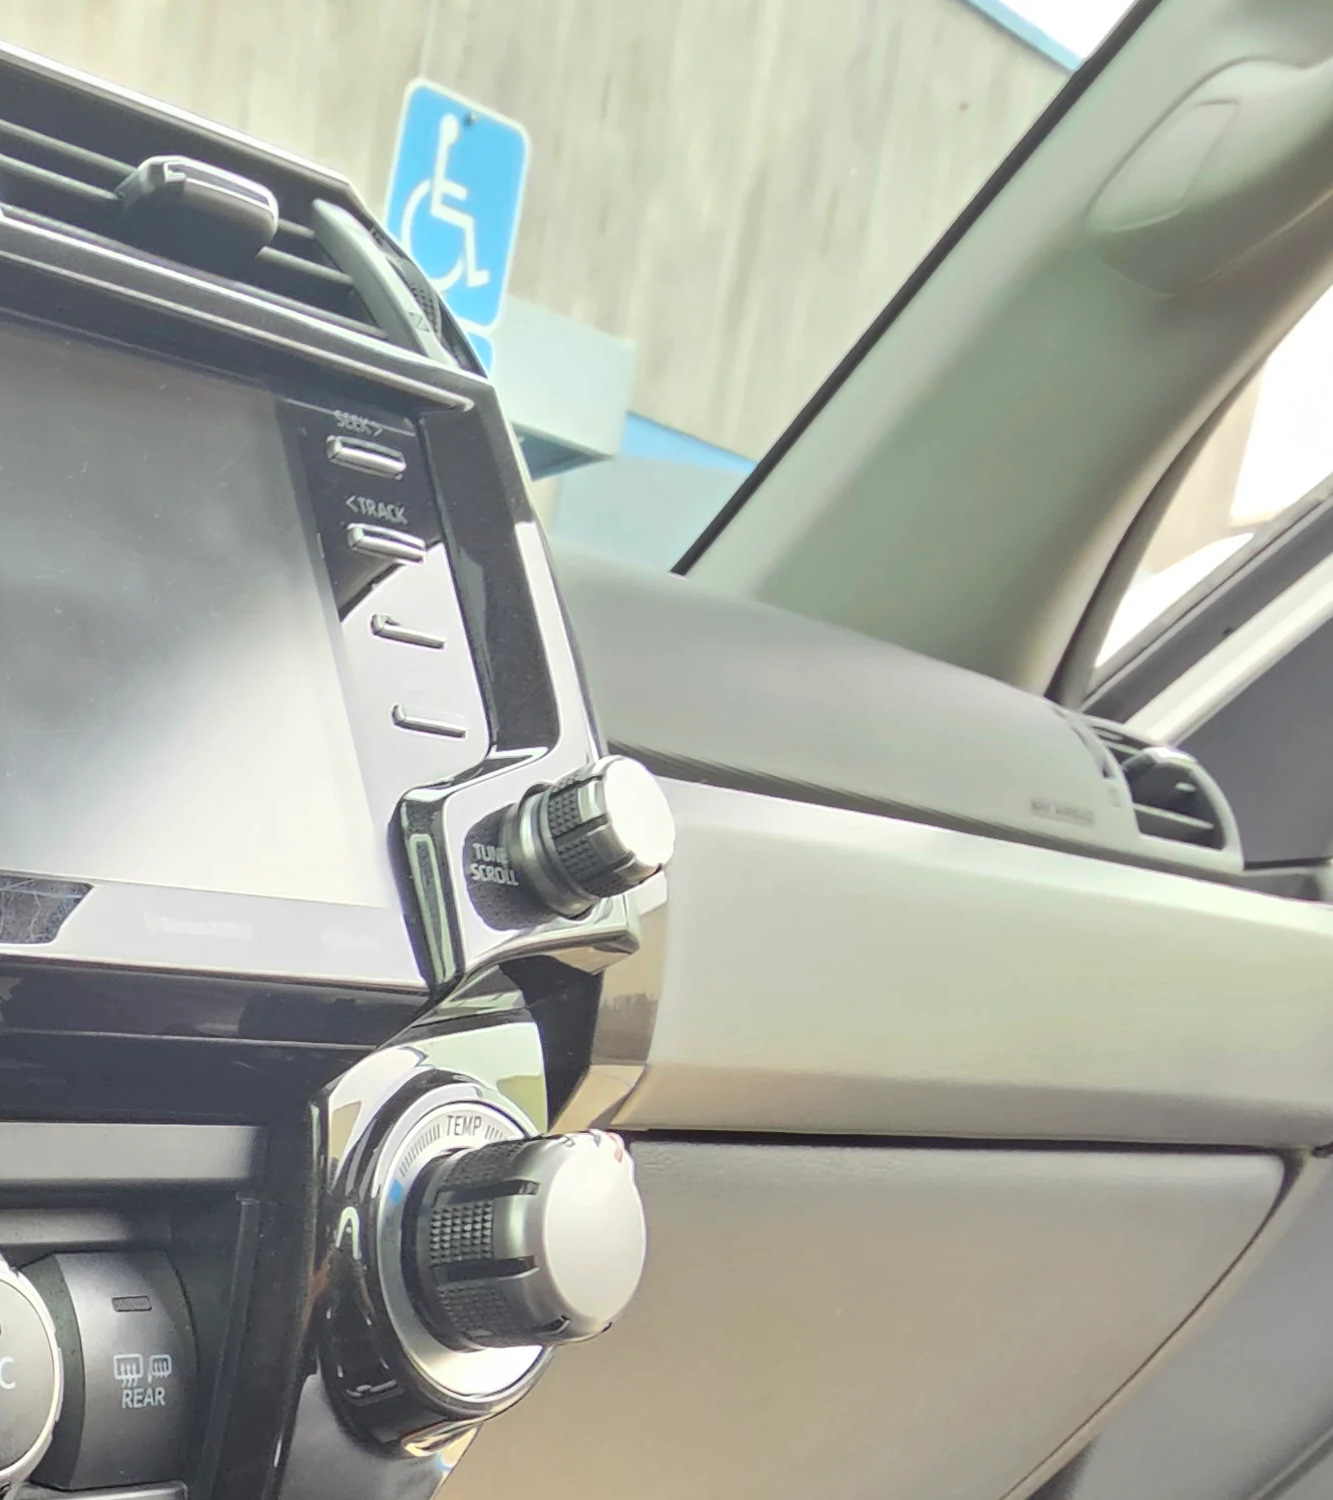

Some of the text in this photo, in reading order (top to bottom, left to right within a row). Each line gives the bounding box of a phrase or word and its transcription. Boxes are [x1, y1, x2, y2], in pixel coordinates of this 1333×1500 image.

[472, 842, 508, 865] TUNE
[470, 863, 520, 887] SCROLL
[444, 1113, 483, 1138] TEMP
[120, 1386, 167, 1411] REAR
